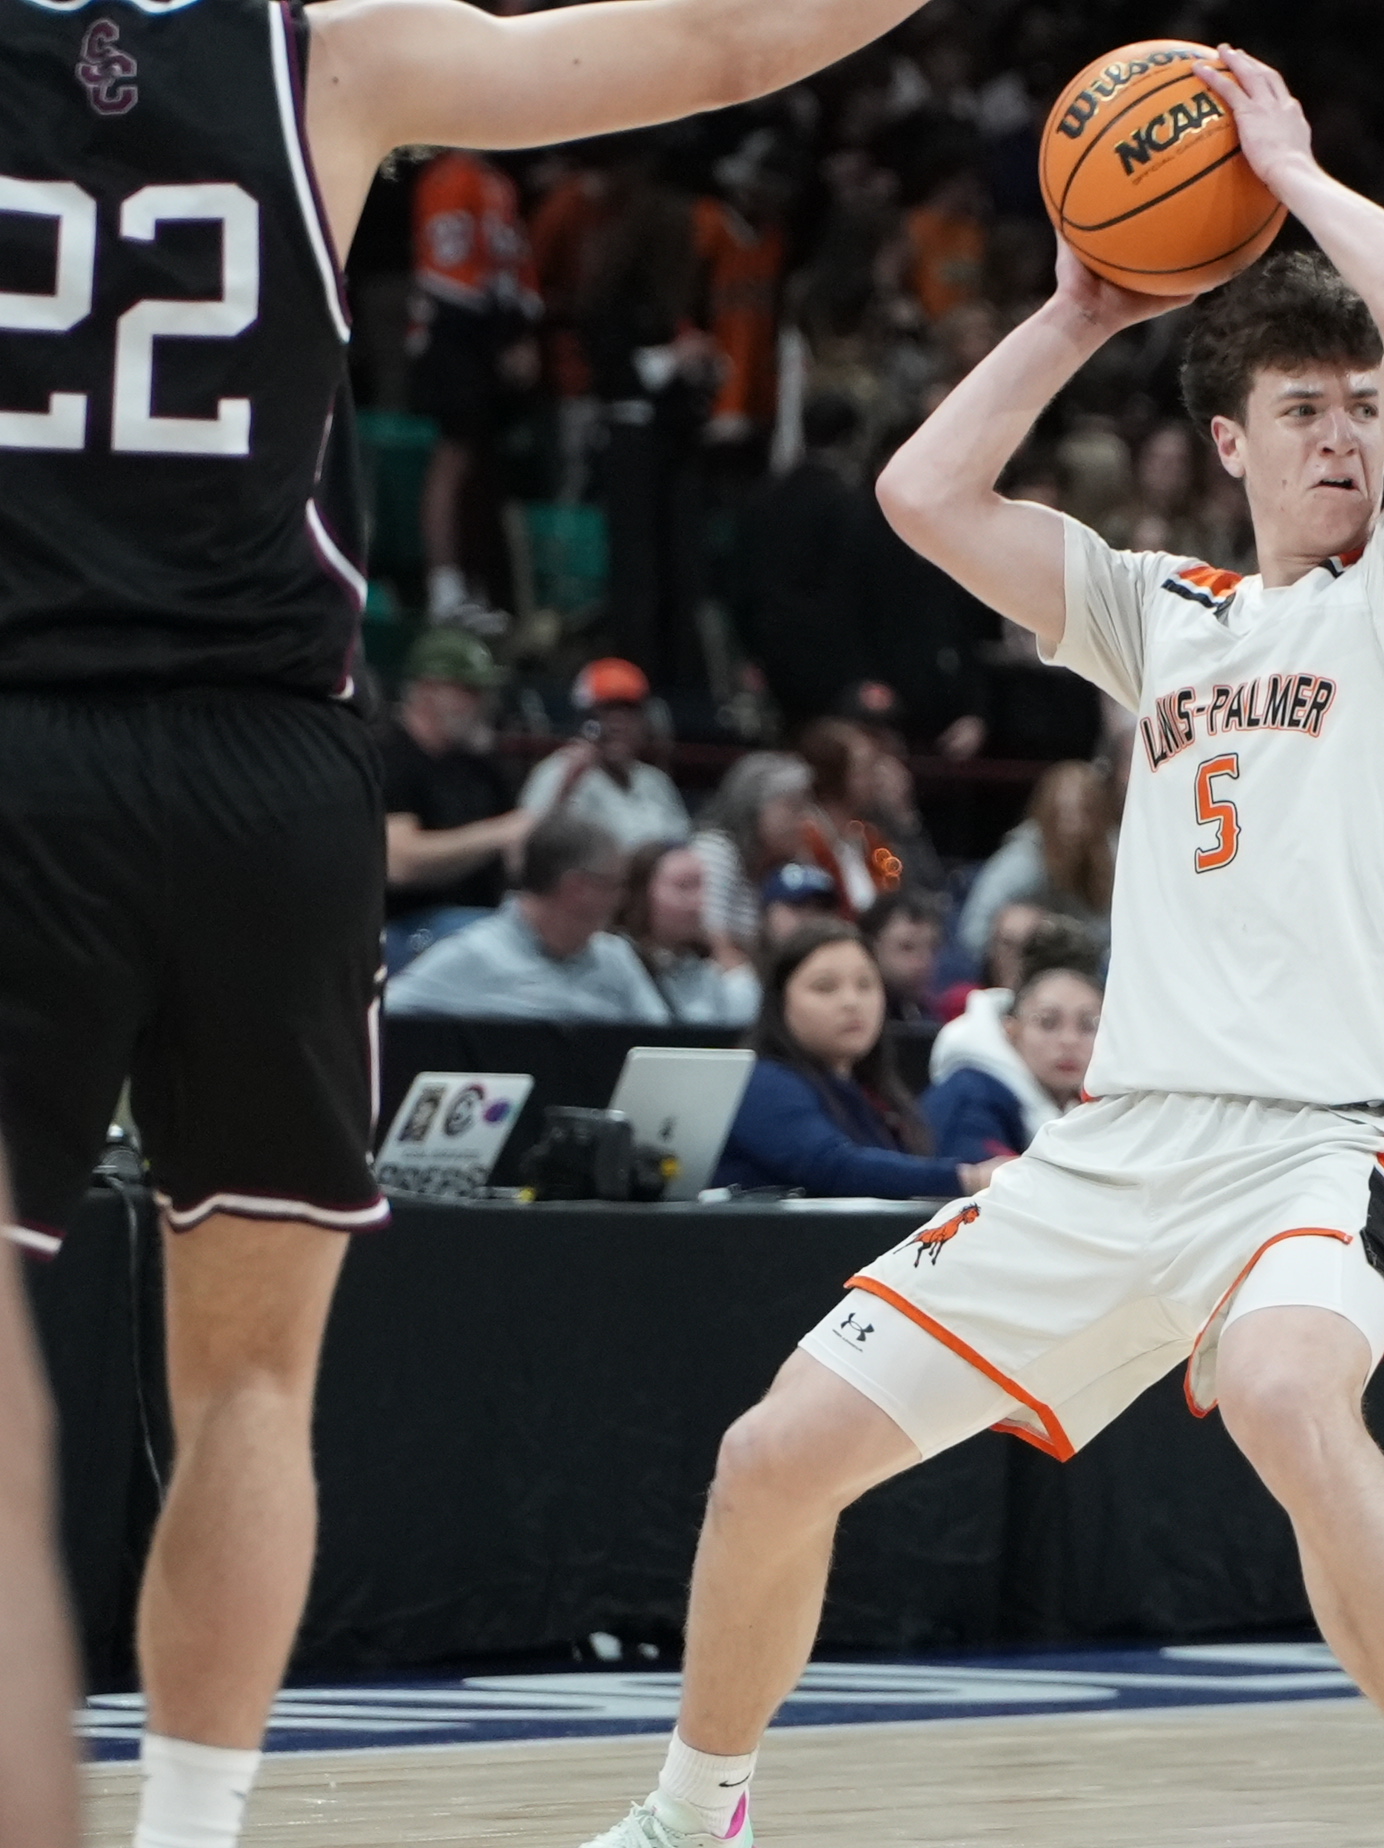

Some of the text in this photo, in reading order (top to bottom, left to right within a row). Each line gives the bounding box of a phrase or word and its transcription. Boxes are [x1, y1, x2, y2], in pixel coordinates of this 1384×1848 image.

[1056, 49, 1206, 139] Wilson
[1114, 92, 1224, 176] NCAA
[0, 176, 260, 455] 22
[1140, 673, 1337, 772] LS-PALMER
[1194, 752, 1241, 874] 5
